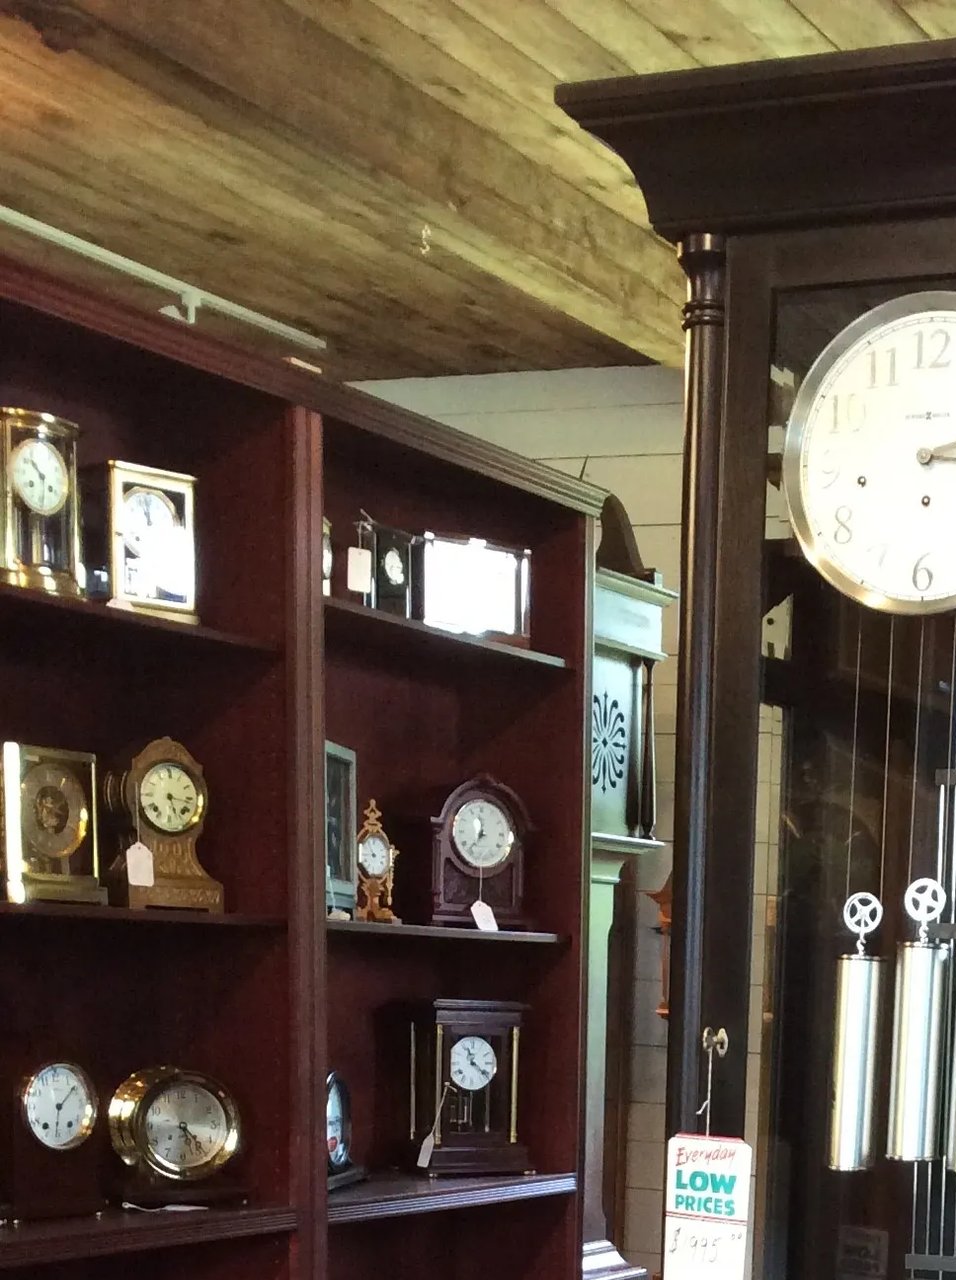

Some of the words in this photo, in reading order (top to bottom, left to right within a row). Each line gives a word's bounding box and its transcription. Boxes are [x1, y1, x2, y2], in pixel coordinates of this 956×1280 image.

[866, 347, 899, 389] 11
[912, 328, 952, 369] 12
[829, 393, 867, 434] 10
[833, 505, 853, 545] 8
[912, 552, 934, 592] 6
[675, 1144, 737, 1167] Everyday
[675, 1169, 737, 1195] LOW
[674, 1194, 736, 1217] PRICES
